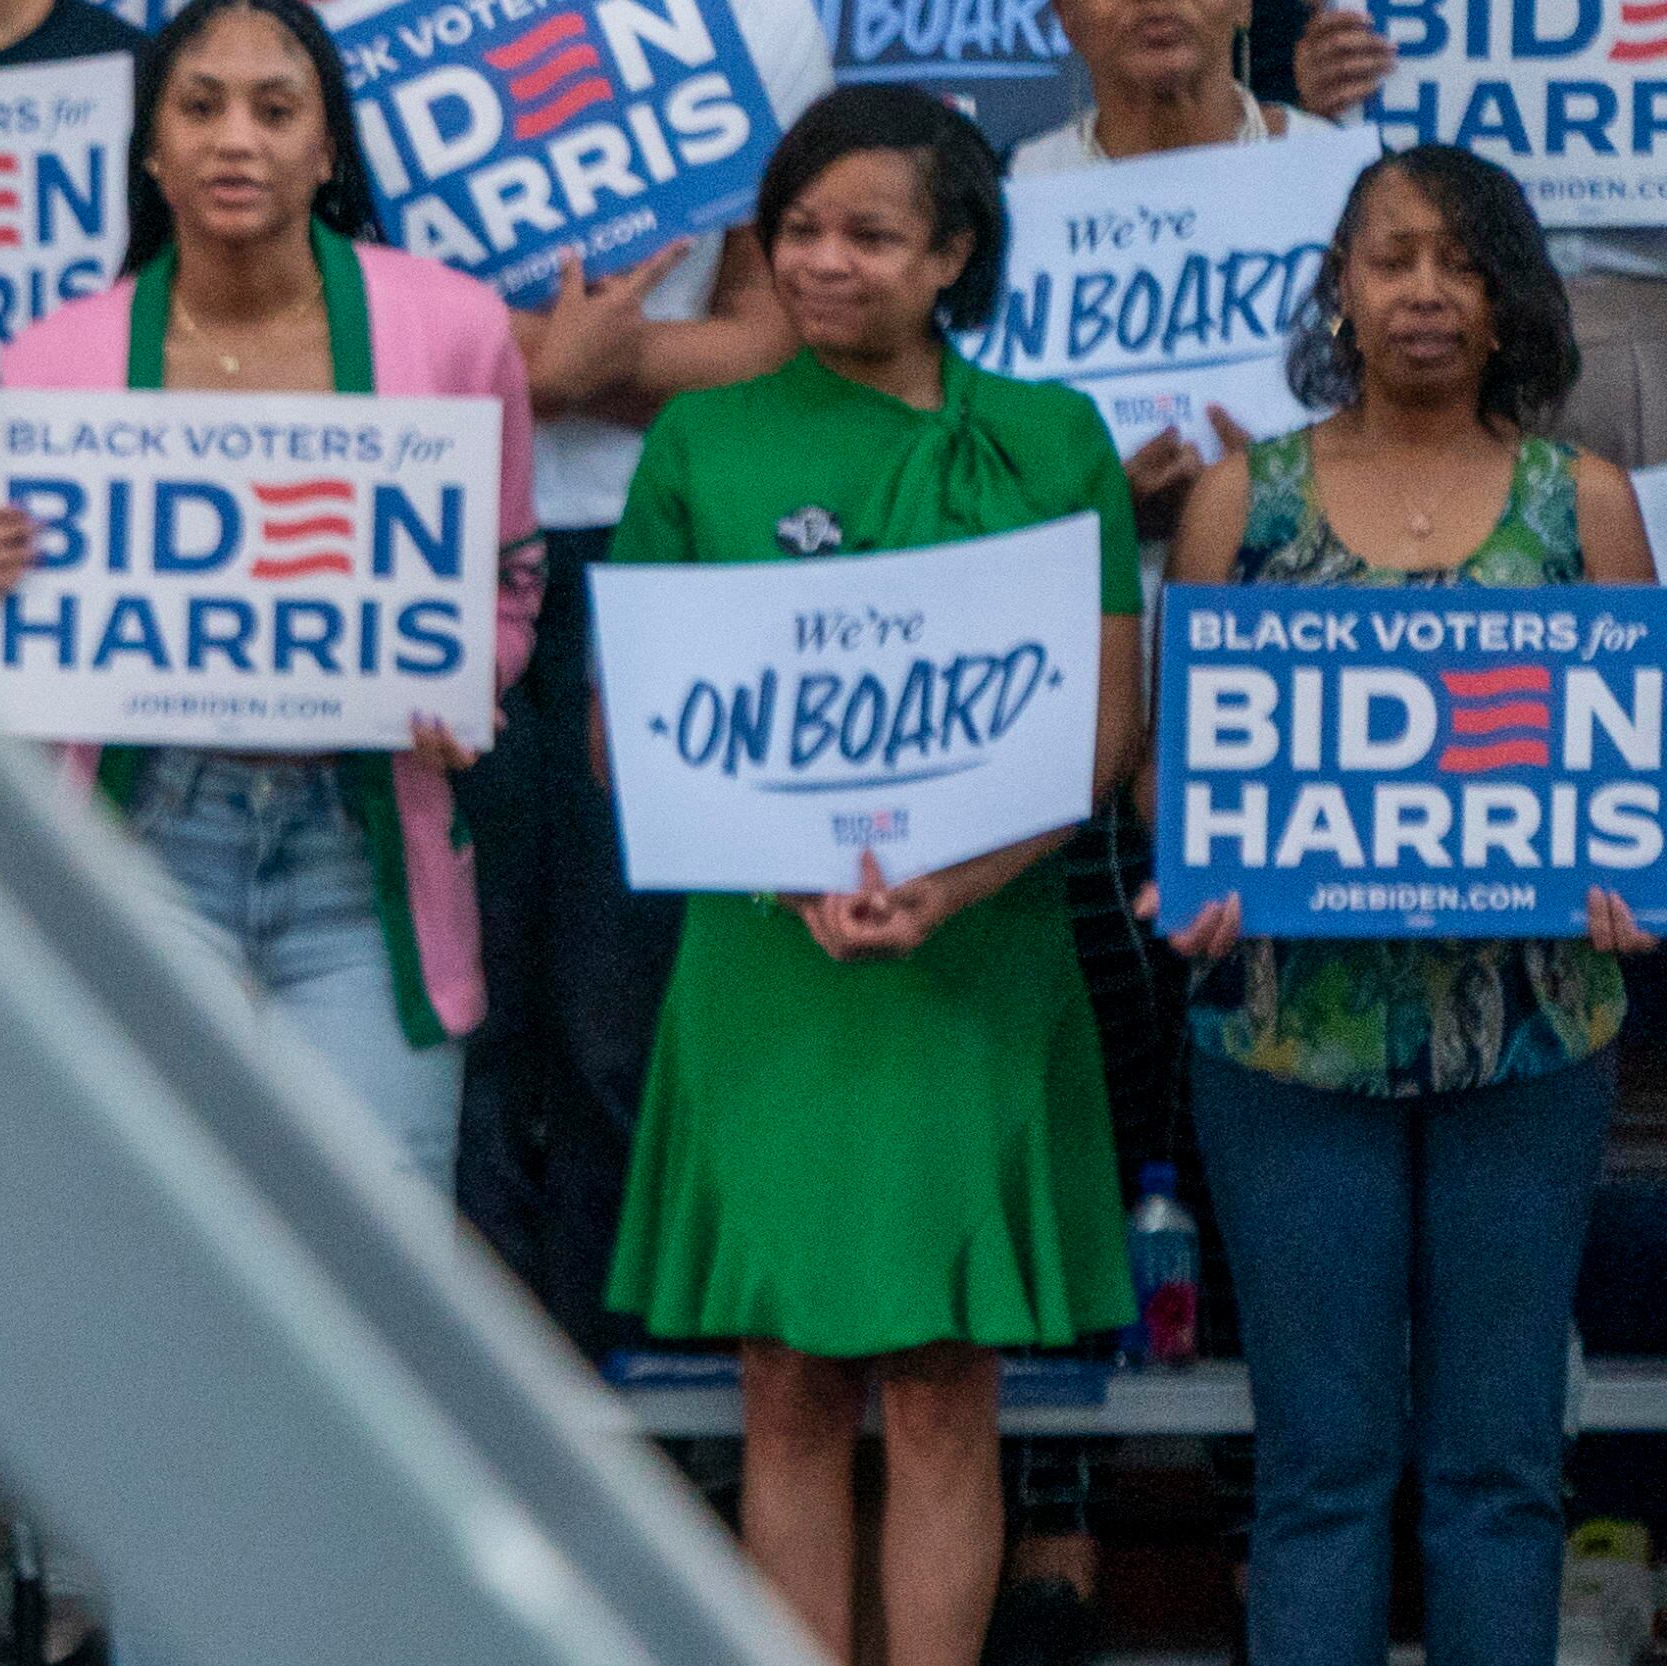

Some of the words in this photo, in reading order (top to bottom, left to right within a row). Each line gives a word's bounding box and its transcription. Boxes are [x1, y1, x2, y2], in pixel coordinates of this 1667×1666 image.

[355, 0, 717, 199] IDEN
[401, 72, 752, 266] ARRIS
[1066, 206, 1197, 255] We're
[6, 420, 167, 460] BLACK
[183, 422, 383, 464] VOTERS
[391, 425, 455, 470] for
[6, 476, 466, 582] BIDEN
[2, 594, 467, 679] HARRIS
[795, 607, 925, 655] We're
[1189, 611, 1359, 652] BLACK
[1372, 612, 1578, 652] VOTERS
[1581, 615, 1649, 662] for
[676, 665, 777, 778] ON
[789, 637, 1049, 769] BOARD
[1188, 665, 1665, 773] BIDEN
[1184, 781, 1665, 870] HARRIS
[1310, 883, 1538, 912] JOEBIDEN.COM
